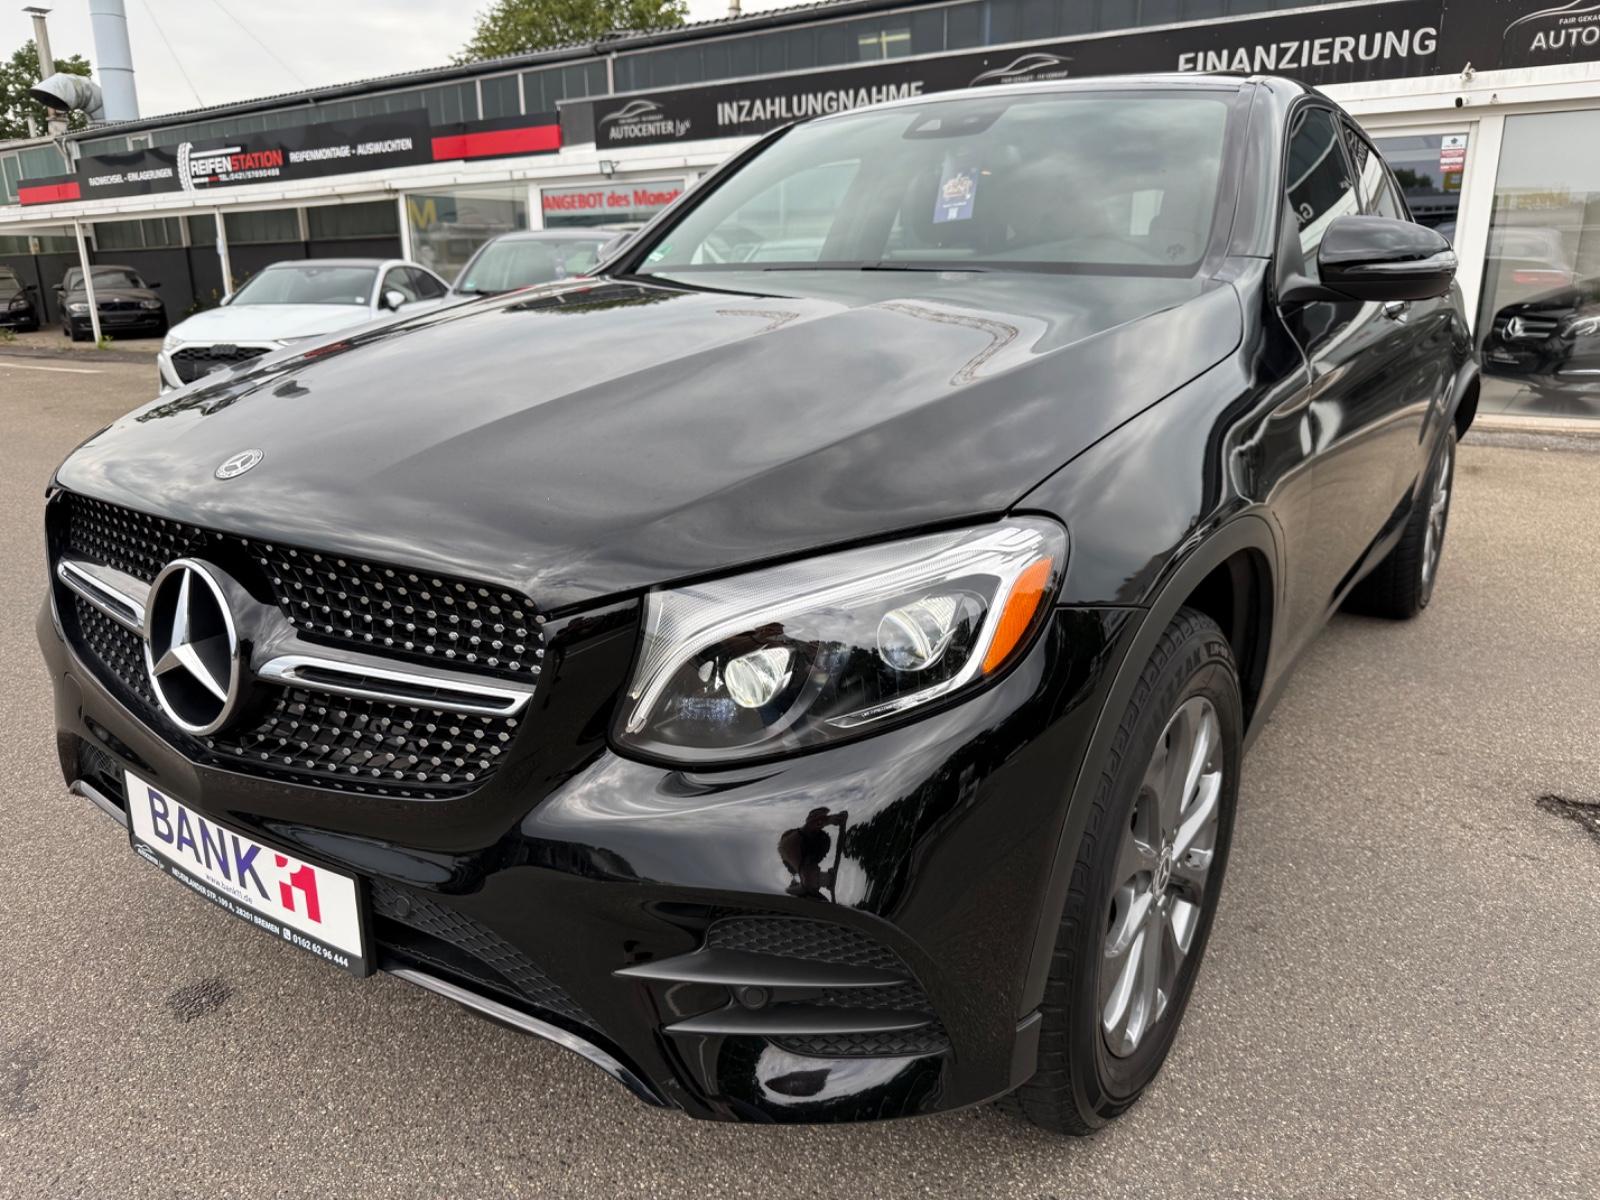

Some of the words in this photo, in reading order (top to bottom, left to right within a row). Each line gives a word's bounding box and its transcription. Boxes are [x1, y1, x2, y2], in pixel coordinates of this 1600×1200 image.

[1178, 27, 1438, 73] FINANZIERUNG
[609, 120, 674, 140] AUTOCENTER
[357, 137, 413, 156] AUSWUCHTEN
[543, 191, 604, 210] ANGEBOT
[607, 190, 630, 207] des
[253, 915, 280, 935] BREMEN
[292, 933, 312, 950] 0162
[311, 942, 322, 955] 62
[322, 948, 333, 961] 96
[333, 953, 349, 968] 444
